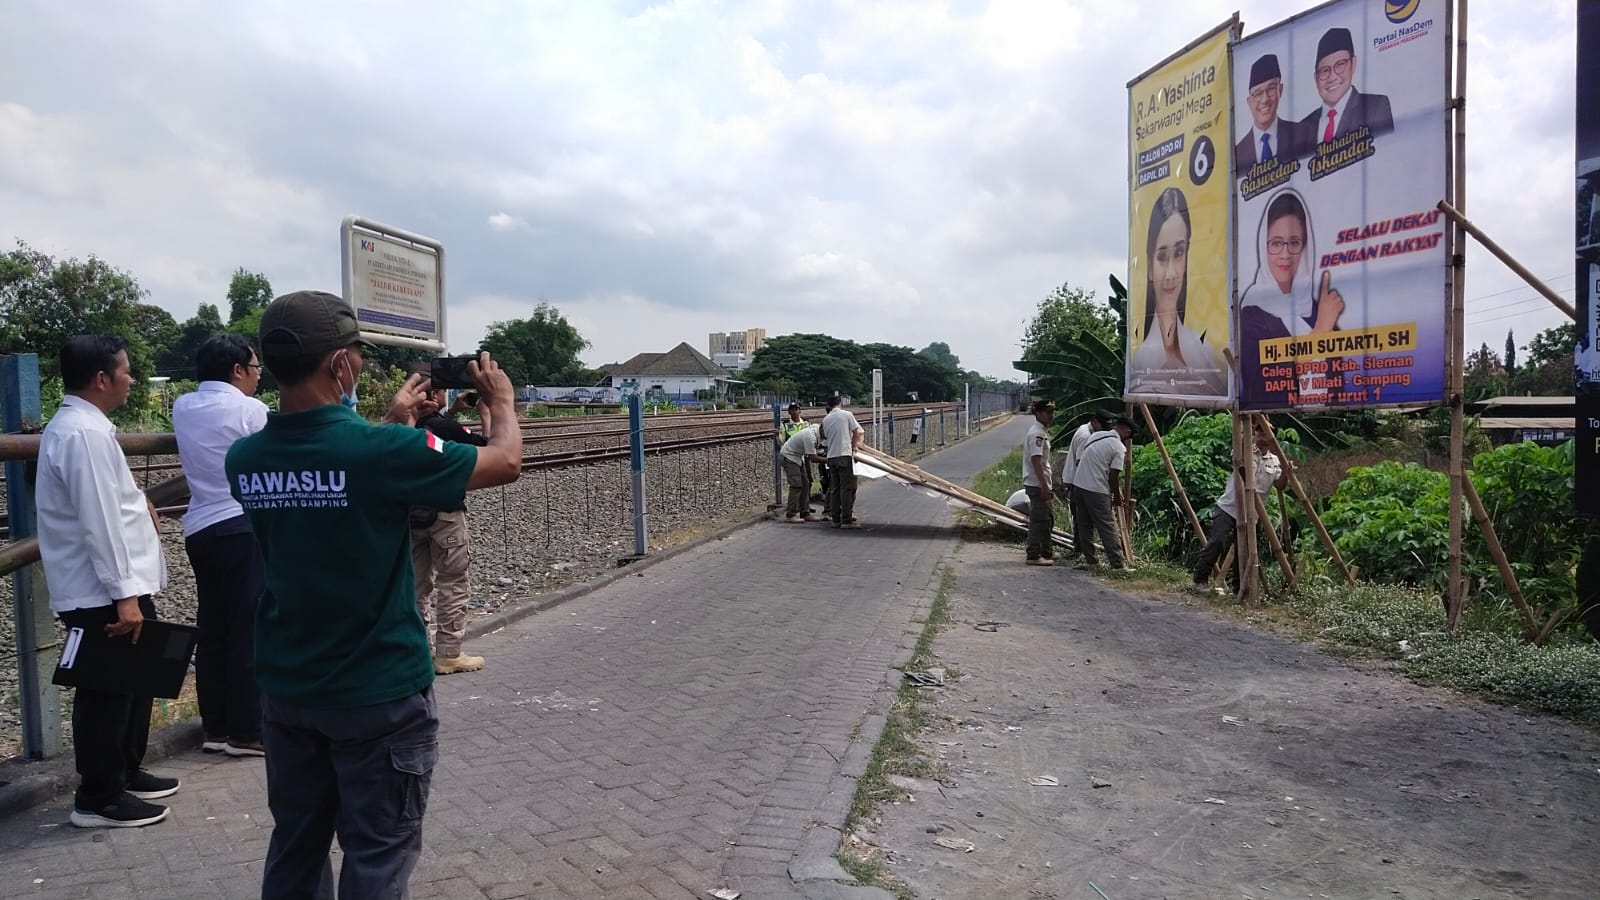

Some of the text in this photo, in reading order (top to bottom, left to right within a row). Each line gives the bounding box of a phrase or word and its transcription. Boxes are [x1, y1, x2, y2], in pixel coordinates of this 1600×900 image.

[1373, 19, 1433, 46] Partai NasDem
[1163, 65, 1215, 107] Yashinta
[1135, 93, 1213, 141] Sekarwangi Mega
[1140, 149, 1161, 165] CALON
[1174, 138, 1183, 151] RI
[1317, 126, 1370, 156] Muhaimin
[1194, 140, 1208, 177] 6
[1248, 157, 1278, 179] Anies
[1309, 138, 1373, 175] Iskandar
[1139, 168, 1157, 185] DAPIL
[1242, 161, 1298, 195] Baswedan
[1335, 209, 1441, 245] SELALU DEKAT
[361, 240, 375, 252] KAI
[1320, 232, 1444, 269] DENGAN RAKYAT
[1264, 330, 1410, 361] Hj. ISMI SUTARTI, SH
[1262, 355, 1413, 378] Caleg DPRD Kab. Sleman
[1265, 380, 1297, 392] DAPIL
[1300, 378, 1310, 390] V
[1312, 376, 1342, 389] Mlati
[1353, 373, 1411, 387] Gamping
[1337, 389, 1368, 402] urut
[1372, 387, 1382, 400] 1
[238, 470, 346, 494] BAWASLU
[300, 499, 348, 508] GAMPING
